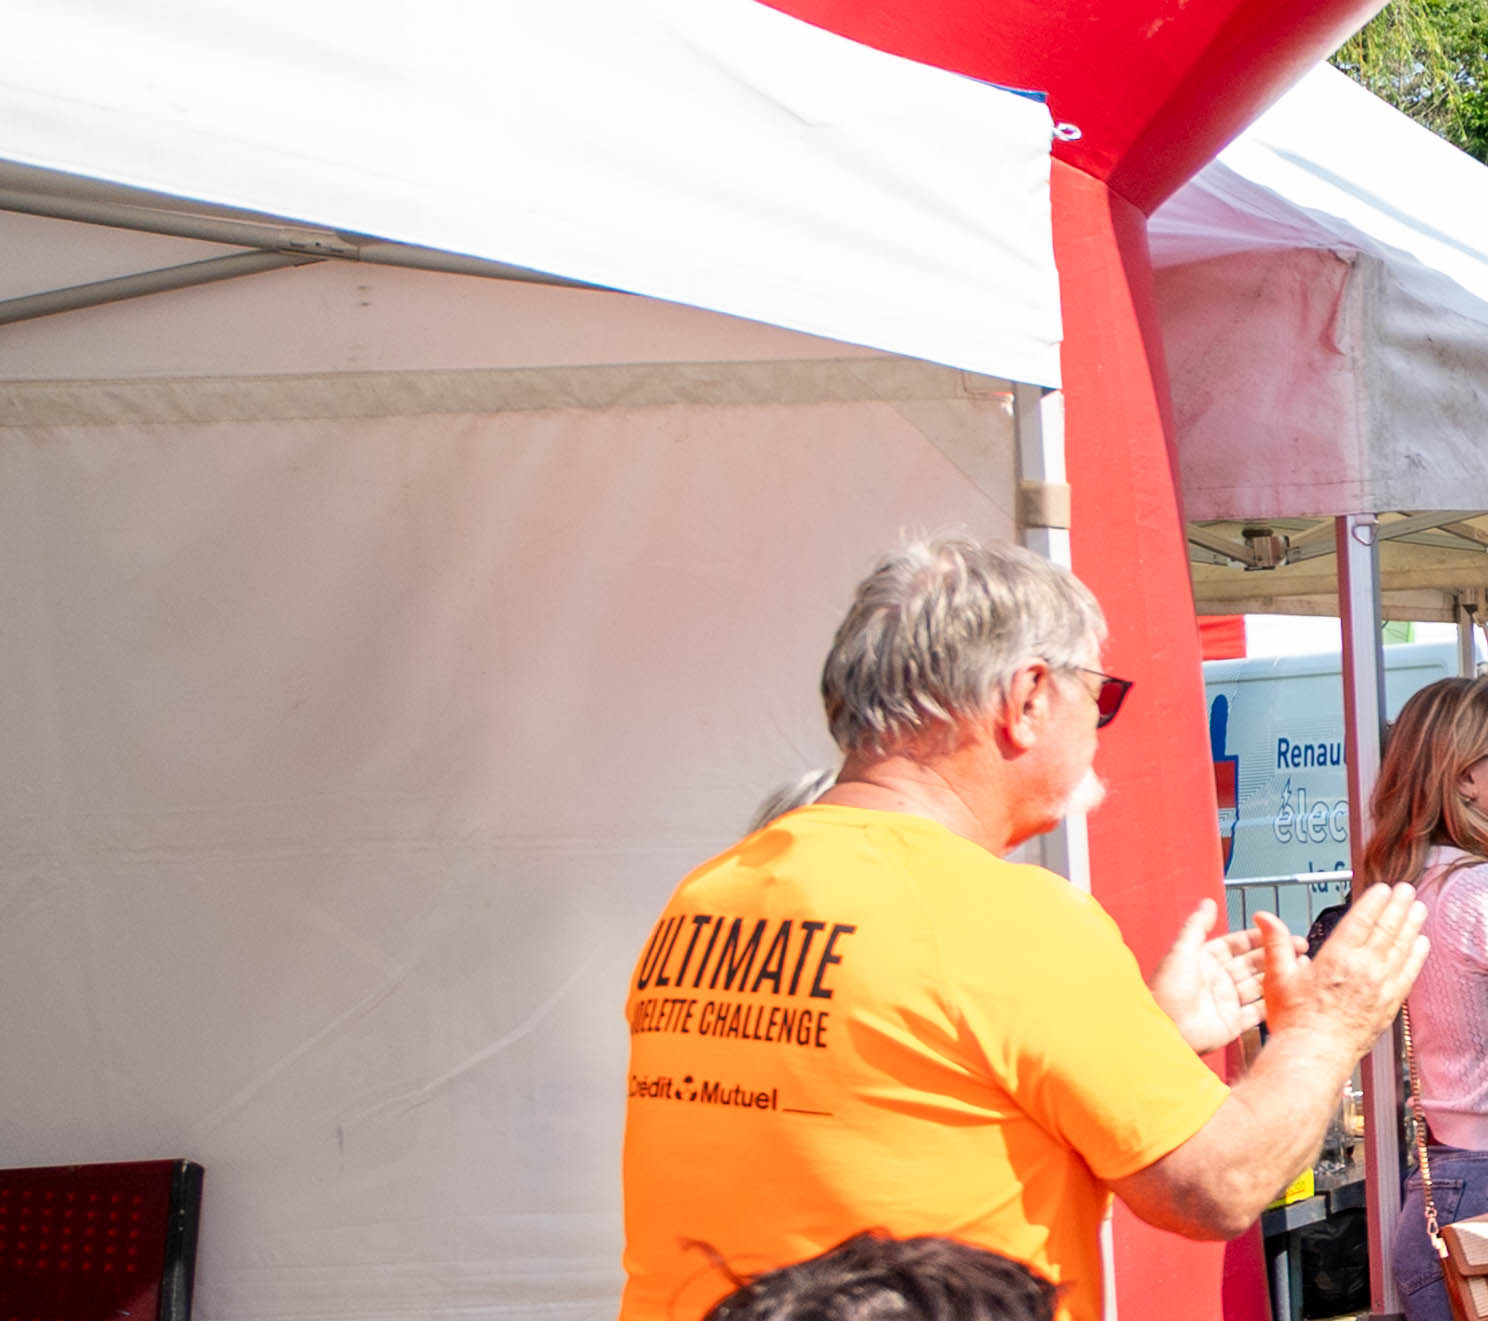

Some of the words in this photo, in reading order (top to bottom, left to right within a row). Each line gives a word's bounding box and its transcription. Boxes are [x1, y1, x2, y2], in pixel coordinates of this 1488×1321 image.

[1277, 736, 1350, 769] Renau
[1273, 776, 1350, 844] élec
[637, 915, 857, 999] ULTIMATE
[700, 1001, 829, 1048] CHALLENGE
[700, 1081, 777, 1110] Mutuel
